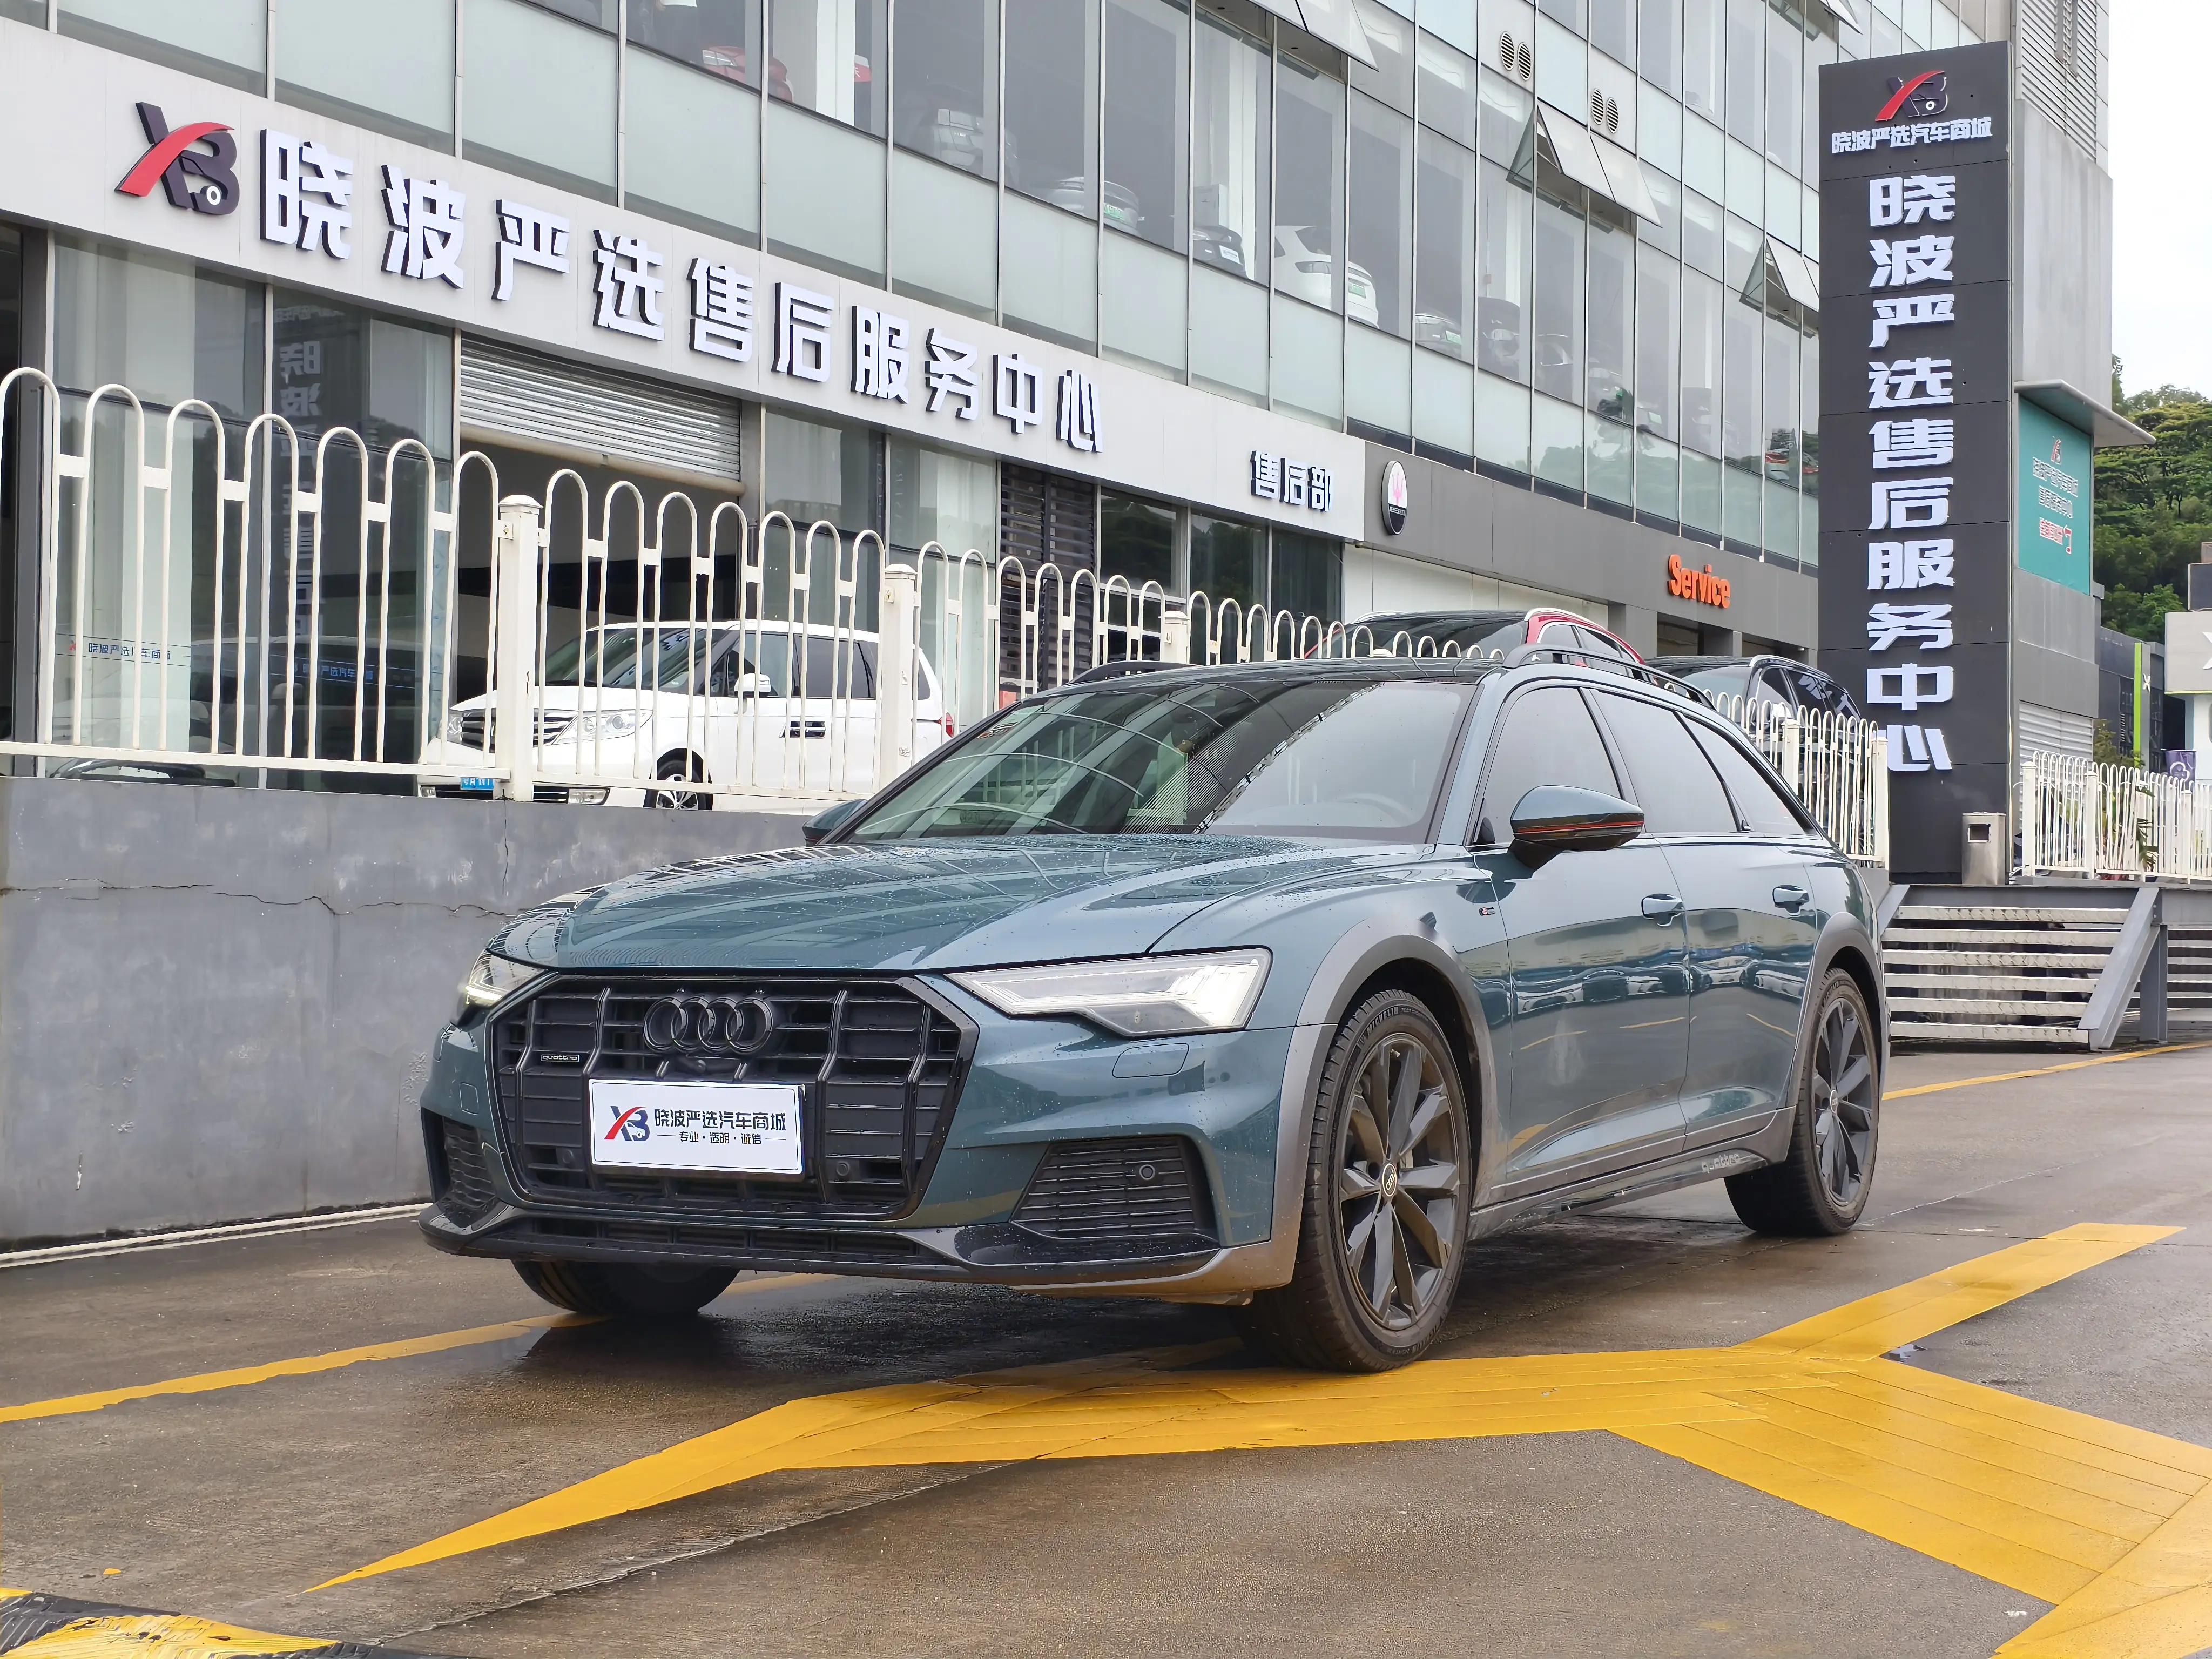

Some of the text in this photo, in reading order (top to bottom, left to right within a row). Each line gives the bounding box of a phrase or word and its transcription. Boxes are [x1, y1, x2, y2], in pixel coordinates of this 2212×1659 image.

[114, 102, 240, 216] XB
[1832, 116, 1992, 154] 晓波严选汽车商城
[259, 129, 1103, 454] 晓波严选售后服务中心
[1251, 450, 1335, 512] 售后部
[1867, 174, 1955, 772] 晓波严选售后服务中心
[1668, 554, 1730, 609] Service
[1367, 1006, 1399, 1037] MICHELIN
[604, 1105, 650, 1142] XB
[655, 1109, 786, 1131] 晓波严选汽车商城
